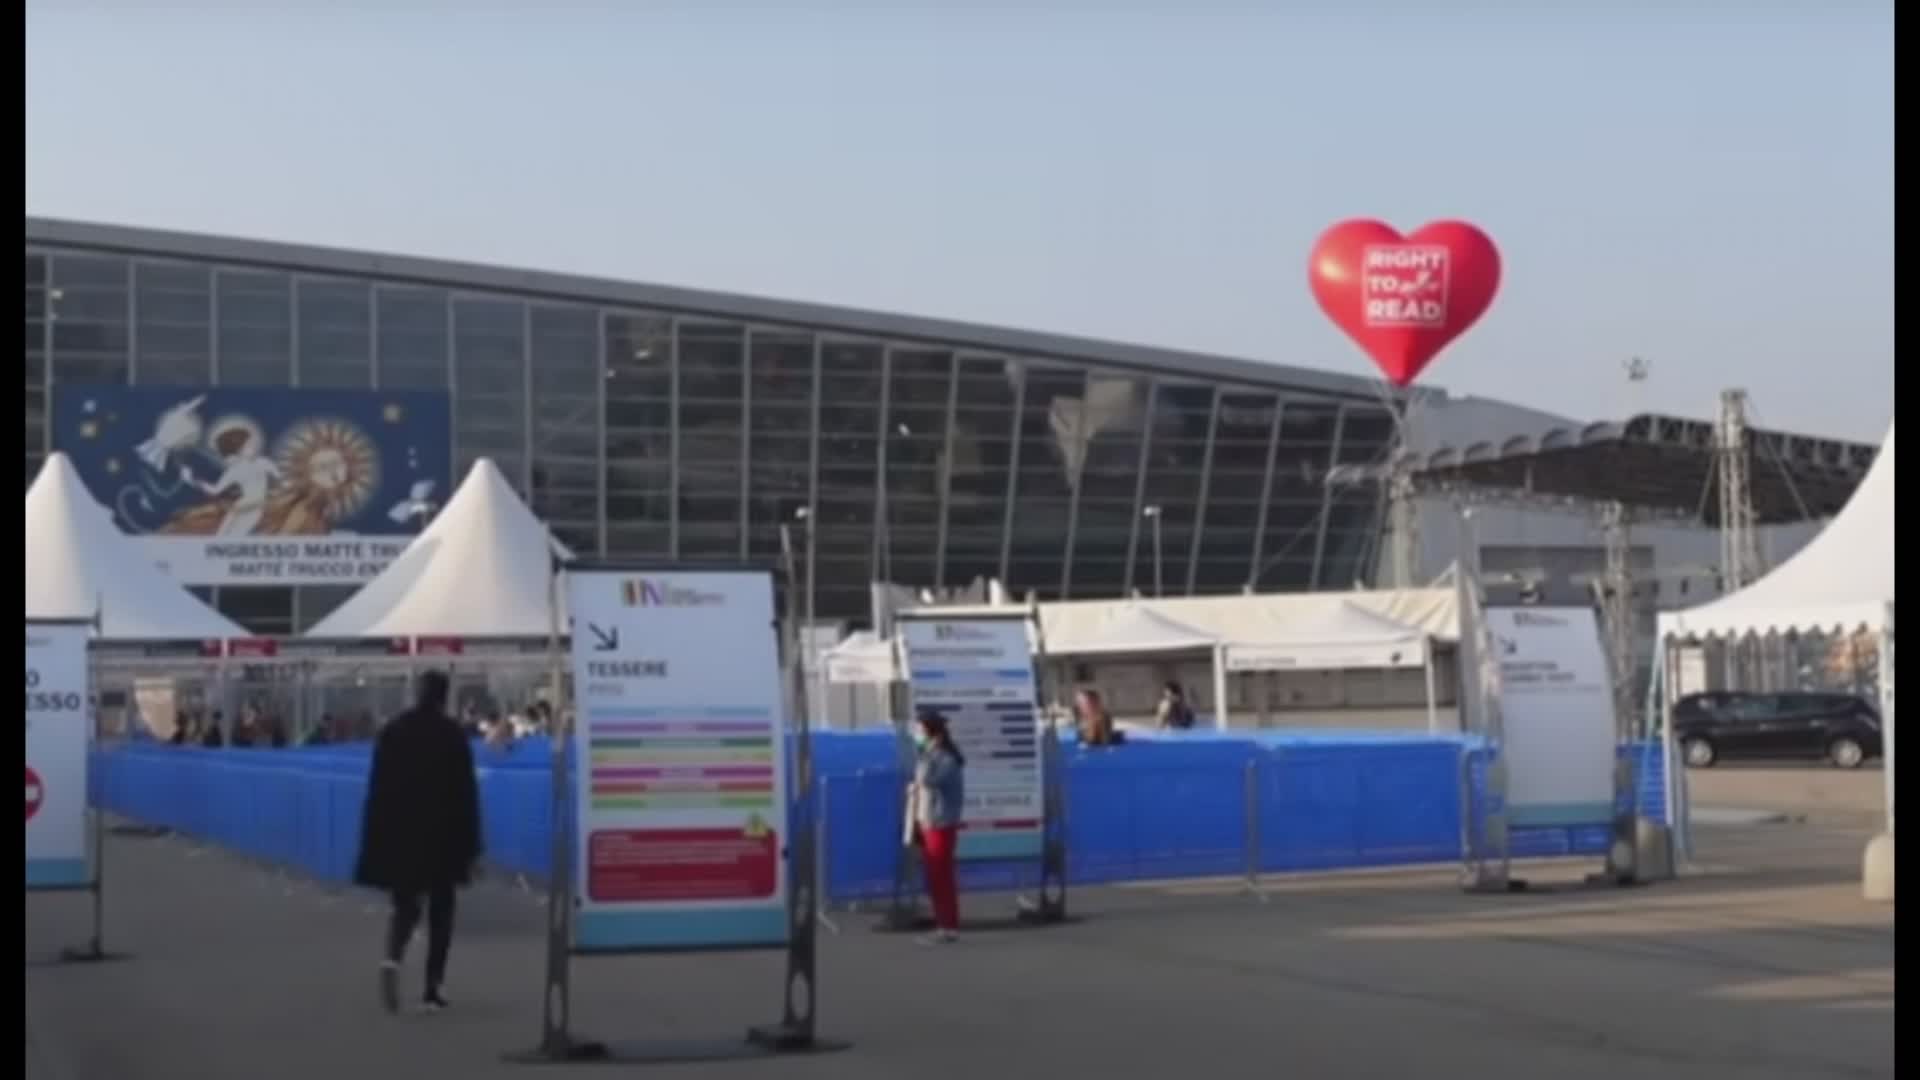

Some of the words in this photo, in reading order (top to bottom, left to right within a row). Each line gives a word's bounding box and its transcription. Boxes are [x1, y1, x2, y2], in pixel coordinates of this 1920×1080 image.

[1366, 249, 1443, 270] RIGHT
[1367, 274, 1399, 293] TO
[1366, 299, 1442, 322] READ
[205, 543, 299, 559] INGRESSO
[303, 543, 362, 559] MATTE
[228, 561, 282, 576] MATTE
[587, 660, 669, 677] TESSERE
